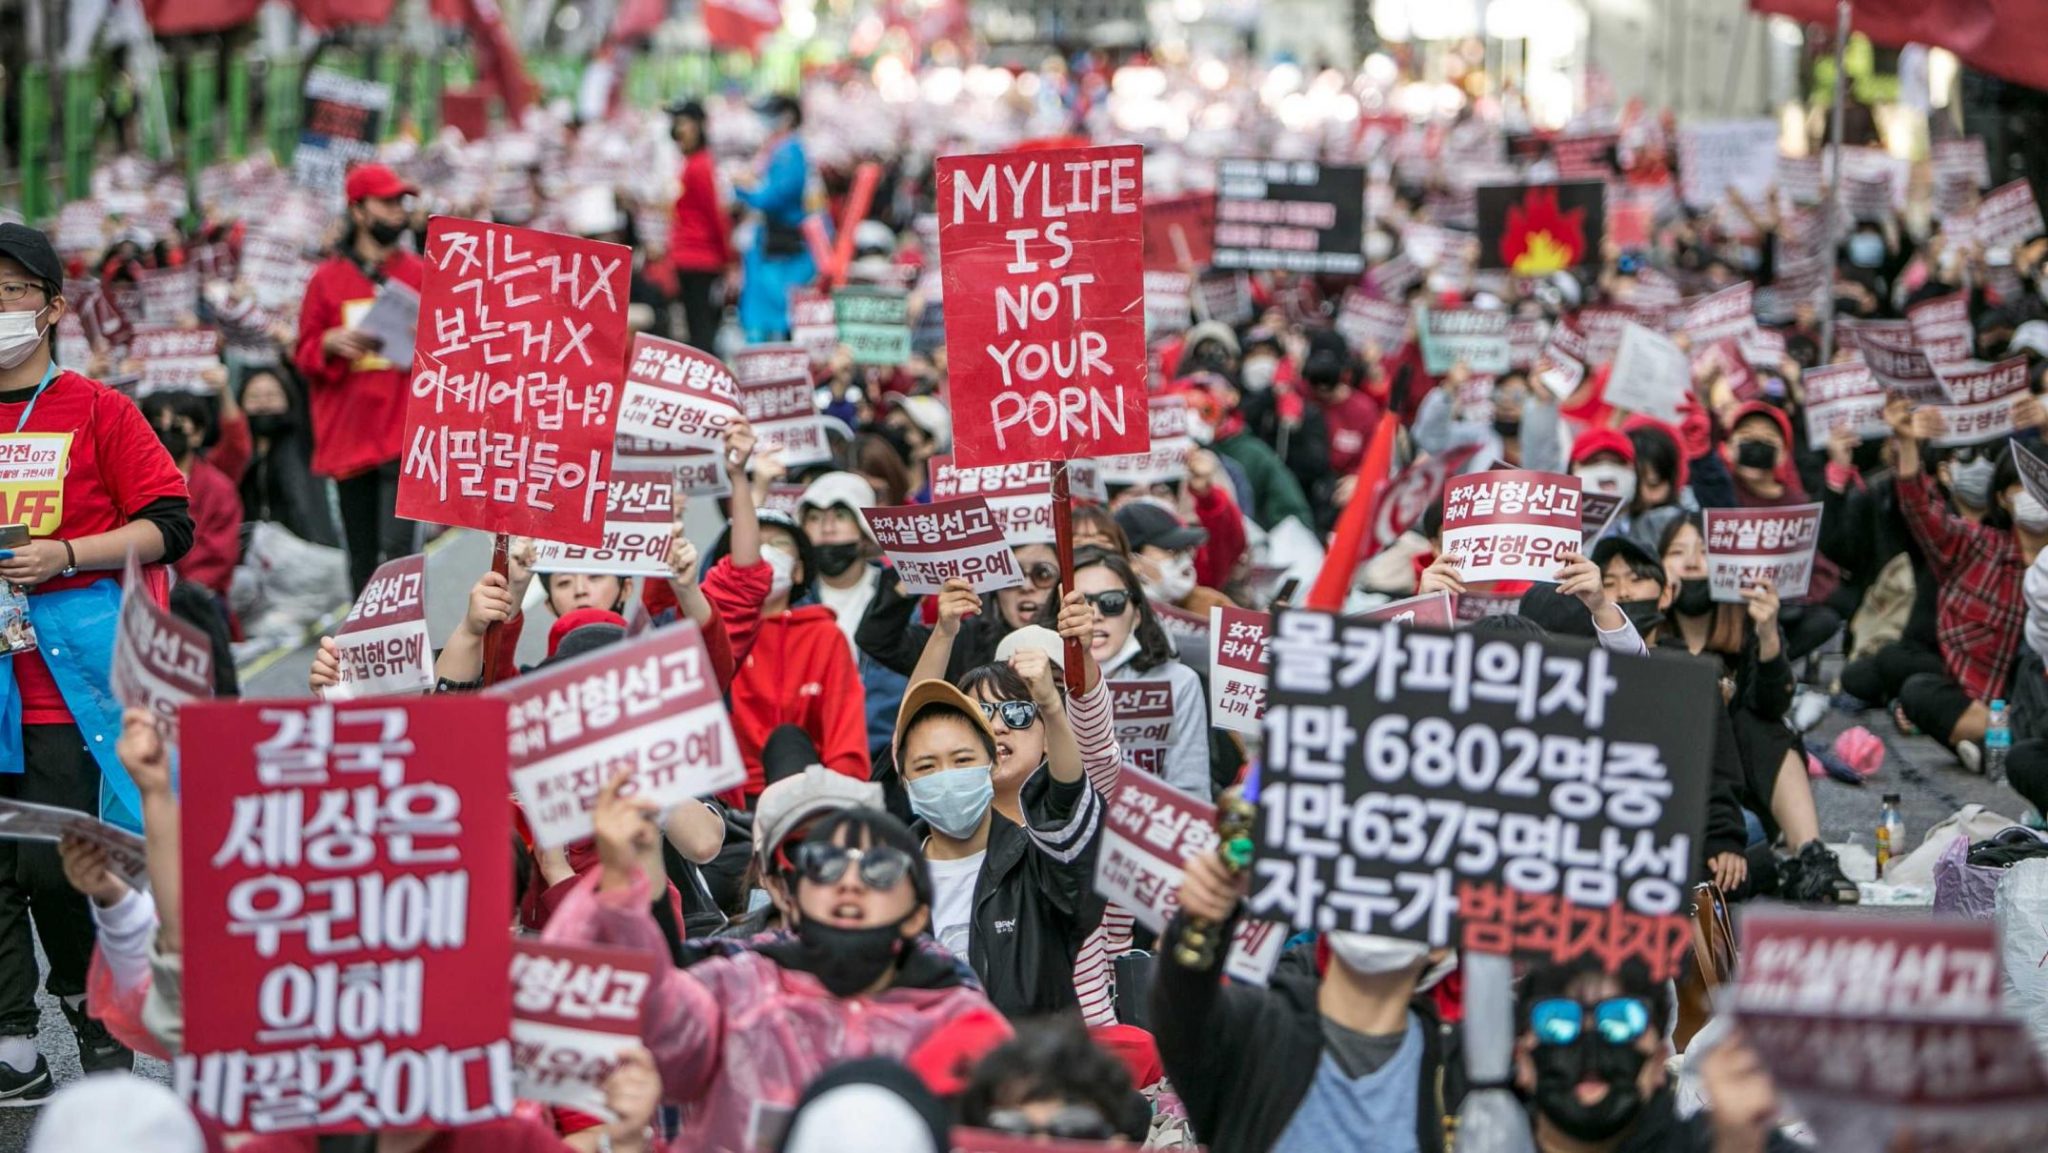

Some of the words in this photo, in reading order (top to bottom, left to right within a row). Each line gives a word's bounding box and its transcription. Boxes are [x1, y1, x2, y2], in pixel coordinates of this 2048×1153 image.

[1006, 221, 1074, 274] IS
[995, 273, 1095, 335] NOT
[661, 353, 742, 408] 실형선
[986, 331, 1115, 387] YOUR
[990, 385, 1126, 450] PORN
[31, 450, 56, 463] 073
[1471, 481, 1580, 518] 실형선고
[895, 507, 993, 545] 실형선고
[916, 549, 1014, 586] 집행유예
[349, 632, 424, 681] 집행유예
[1221, 640, 1254, 664] 라서
[1227, 620, 1263, 643] 女자
[1225, 679, 1257, 701] 男자
[1271, 610, 1617, 729] 몰카피의자
[545, 648, 705, 746] 실형선고
[1111, 688, 1170, 714] 선고
[1219, 697, 1249, 717] 니까
[255, 702, 415, 788] 결국
[1113, 722, 1170, 743] 유예
[211, 780, 464, 868] 세상은
[226, 868, 469, 957] 우리에
[255, 955, 425, 1043] 의해
